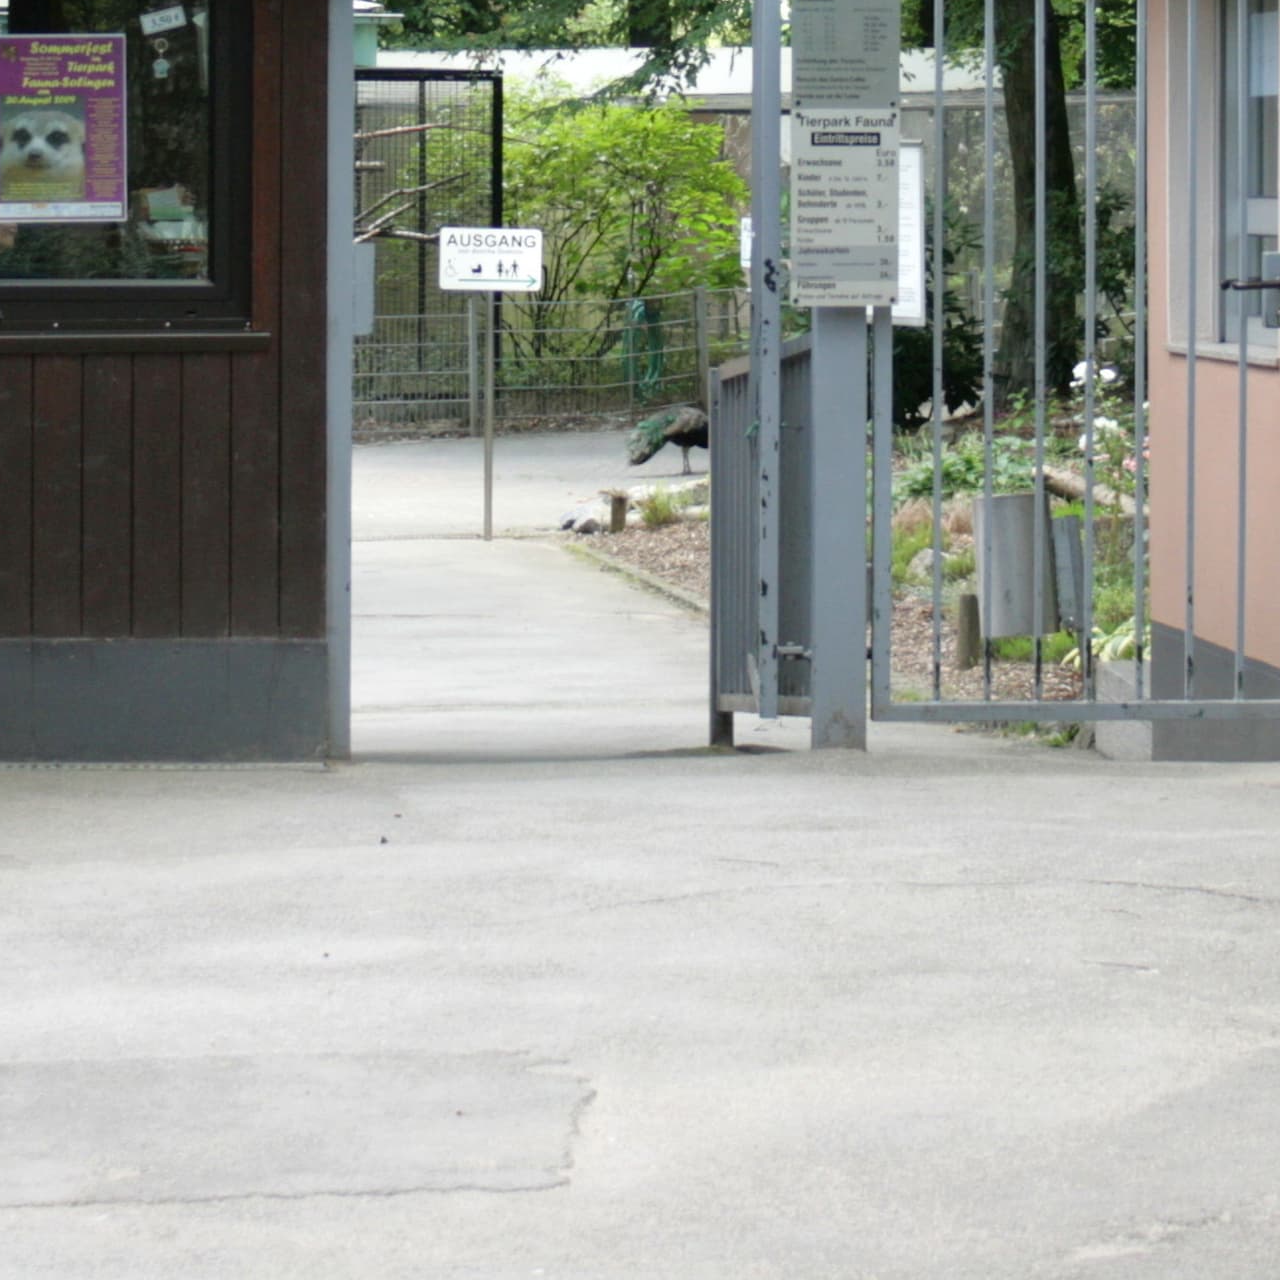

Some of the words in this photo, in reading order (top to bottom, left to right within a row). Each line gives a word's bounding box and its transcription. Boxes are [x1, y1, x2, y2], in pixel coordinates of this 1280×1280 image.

[30, 41, 114, 56] Sommerfest
[67, 61, 115, 75] Tierpark
[800, 115, 851, 129] Tierpark
[855, 115, 895, 128] Fauna
[446, 233, 537, 249] AUSGANG
